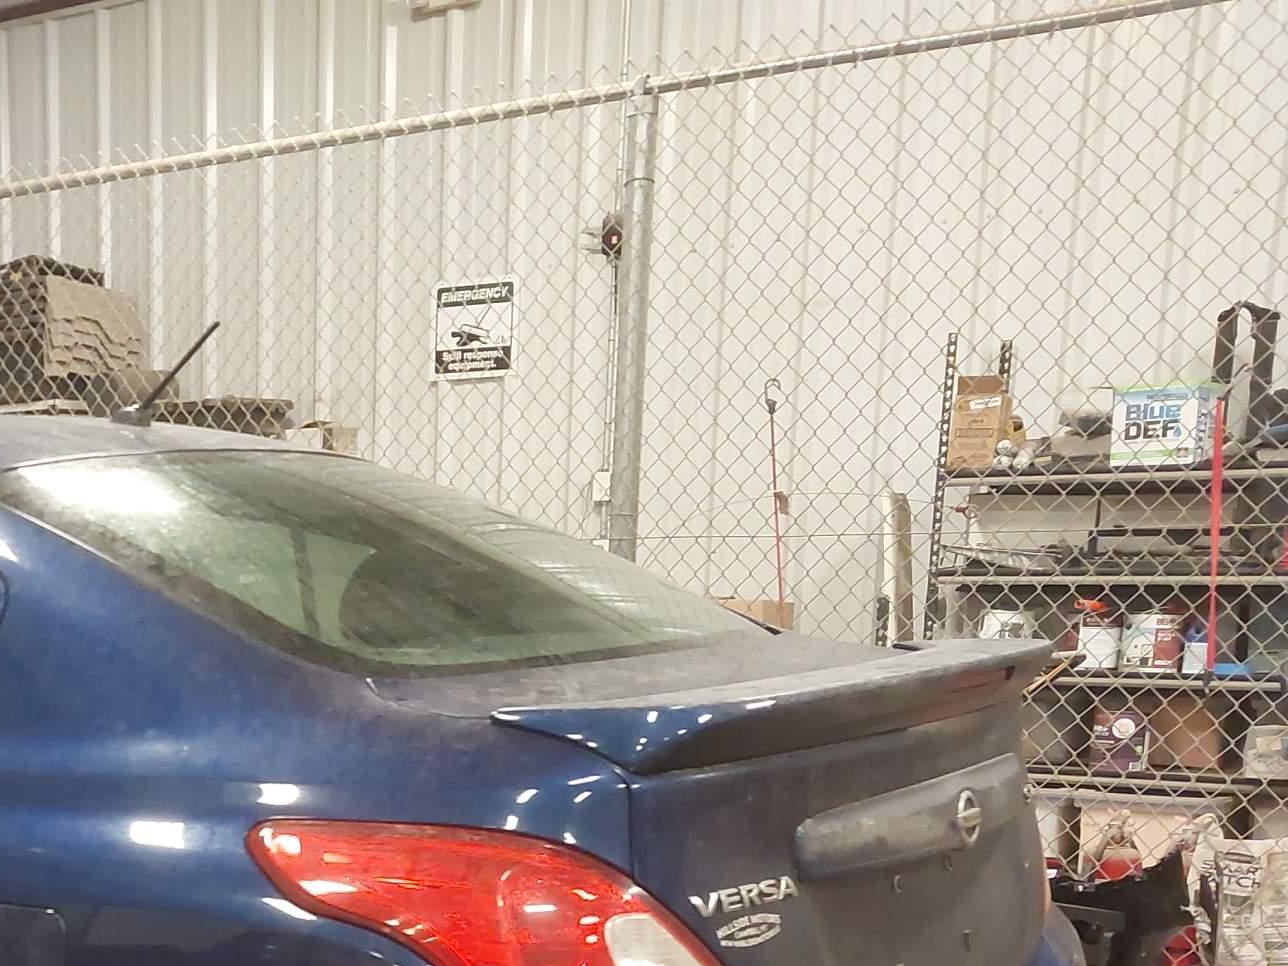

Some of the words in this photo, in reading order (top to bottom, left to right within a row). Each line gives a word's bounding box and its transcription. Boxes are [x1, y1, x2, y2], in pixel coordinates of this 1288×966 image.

[441, 286, 509, 304] EMERGENCY
[464, 349, 504, 362] response
[1124, 419, 1181, 441] DEF
[688, 875, 799, 918] VERSA
